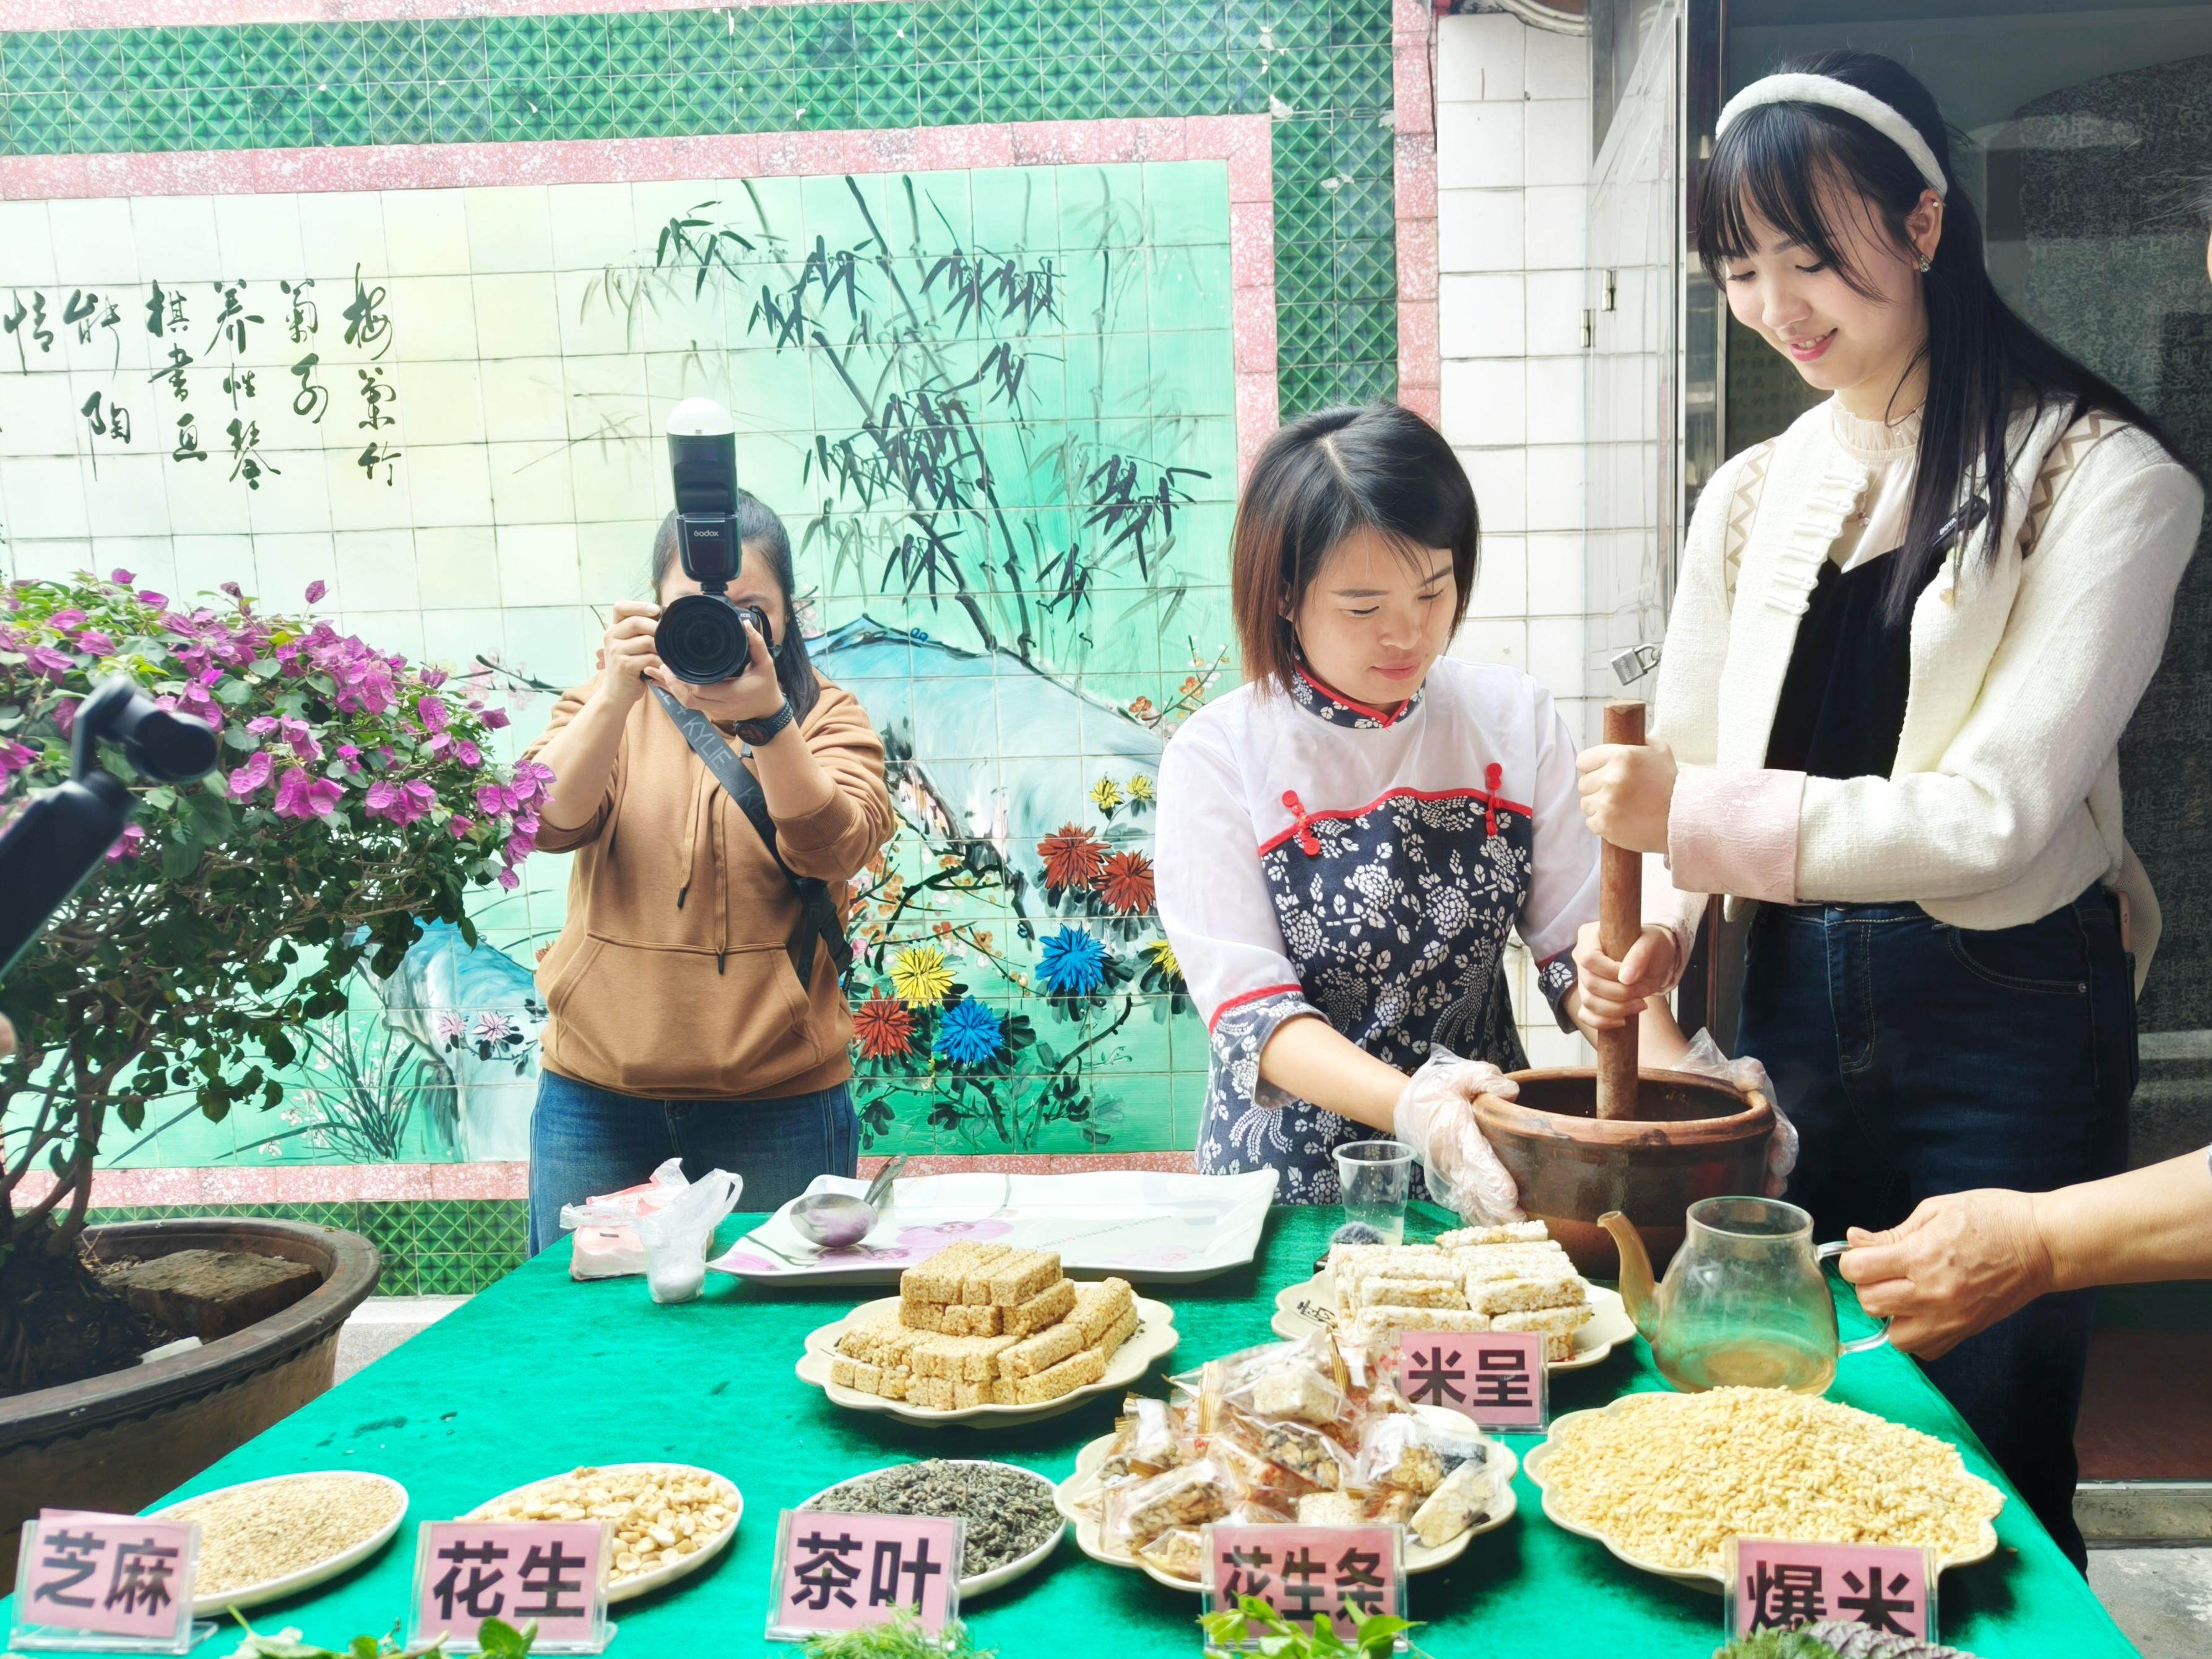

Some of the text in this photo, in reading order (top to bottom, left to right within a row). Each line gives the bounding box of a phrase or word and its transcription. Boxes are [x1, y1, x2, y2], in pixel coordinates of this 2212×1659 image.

[683, 715, 733, 769] KYLIE
[1407, 1347, 1533, 1408] 米呈
[33, 1529, 180, 1617] 芝麻
[433, 1540, 587, 1620] 花生
[790, 1531, 941, 1616] 茶叶
[1222, 1545, 1386, 1624] 花生条
[1746, 1559, 1916, 1638] 爆米
